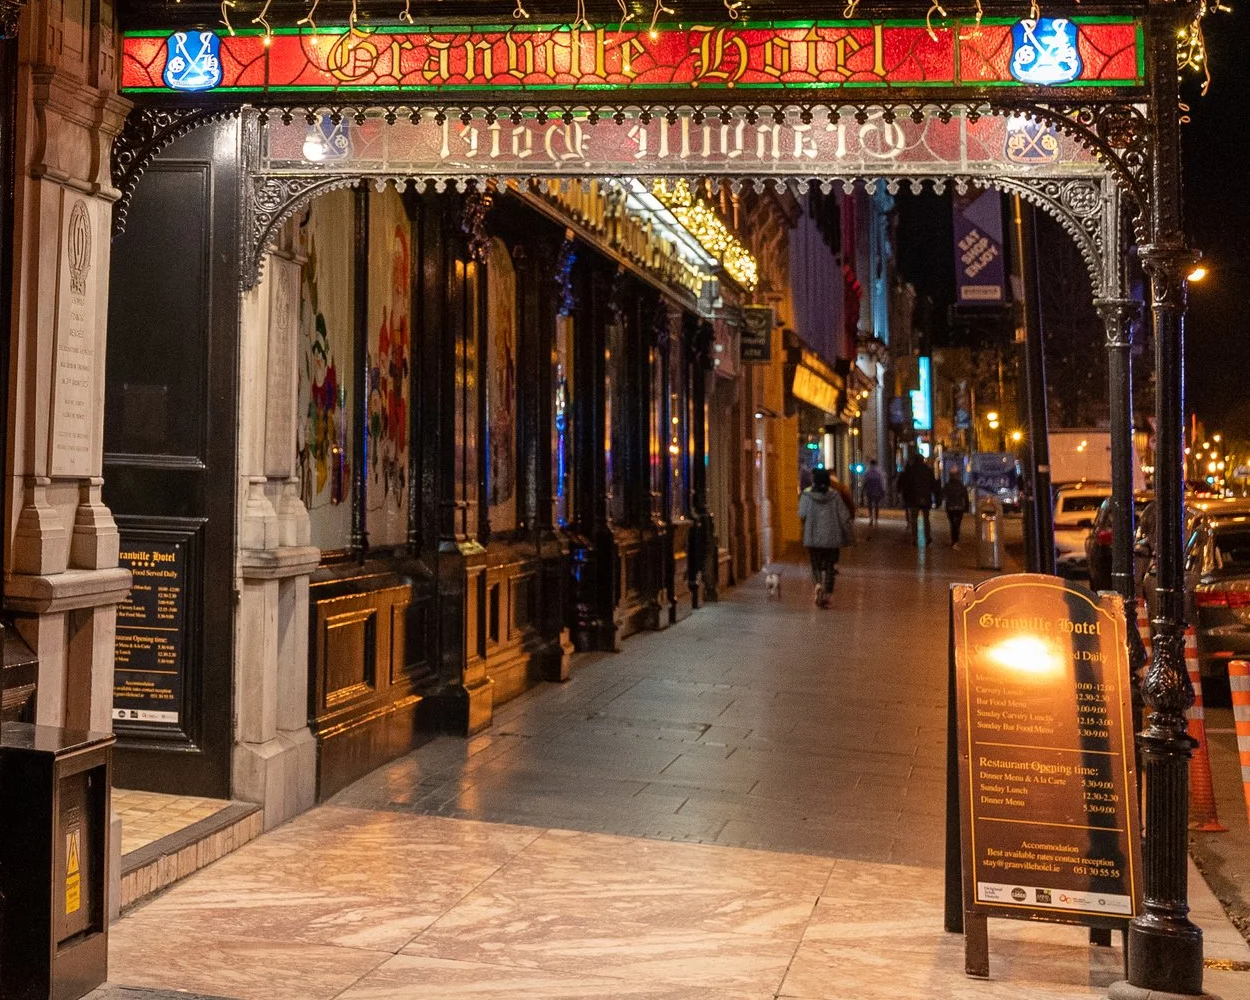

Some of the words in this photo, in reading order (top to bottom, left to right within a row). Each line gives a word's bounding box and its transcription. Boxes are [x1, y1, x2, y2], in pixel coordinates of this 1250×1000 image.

[327, 26, 646, 83] Granville
[690, 23, 886, 88] Hotel
[119, 552, 150, 561] ranville
[152, 551, 176, 562] Hotel
[163, 570, 178, 579] Daily
[979, 613, 1052, 631] Granville
[1059, 617, 1101, 635] Hotel
[1082, 650, 1108, 664] Daily
[976, 709, 1001, 719] Sunday
[977, 721, 1002, 731] Sunday
[1016, 724, 1033, 732] Food
[979, 757, 1029, 770] Restaurant
[1031, 760, 1071, 776] Opening
[1074, 764, 1099, 776] time:
[980, 771, 1003, 781] Dinner
[1004, 773, 1024, 782] Menu
[1025, 774, 1031, 782] &
[1047, 776, 1067, 785] Carte
[980, 783, 1005, 793] Sunday
[1006, 785, 1028, 795] Lunch
[981, 796, 1004, 805] Dinner
[1005, 797, 1025, 806] Menu
[1021, 840, 1079, 853] Accommodation
[987, 848, 1003, 857] Best
[1004, 850, 1035, 860] available
[1037, 853, 1053, 861] rates
[1054, 855, 1080, 864] contact
[1081, 857, 1114, 867] reception
